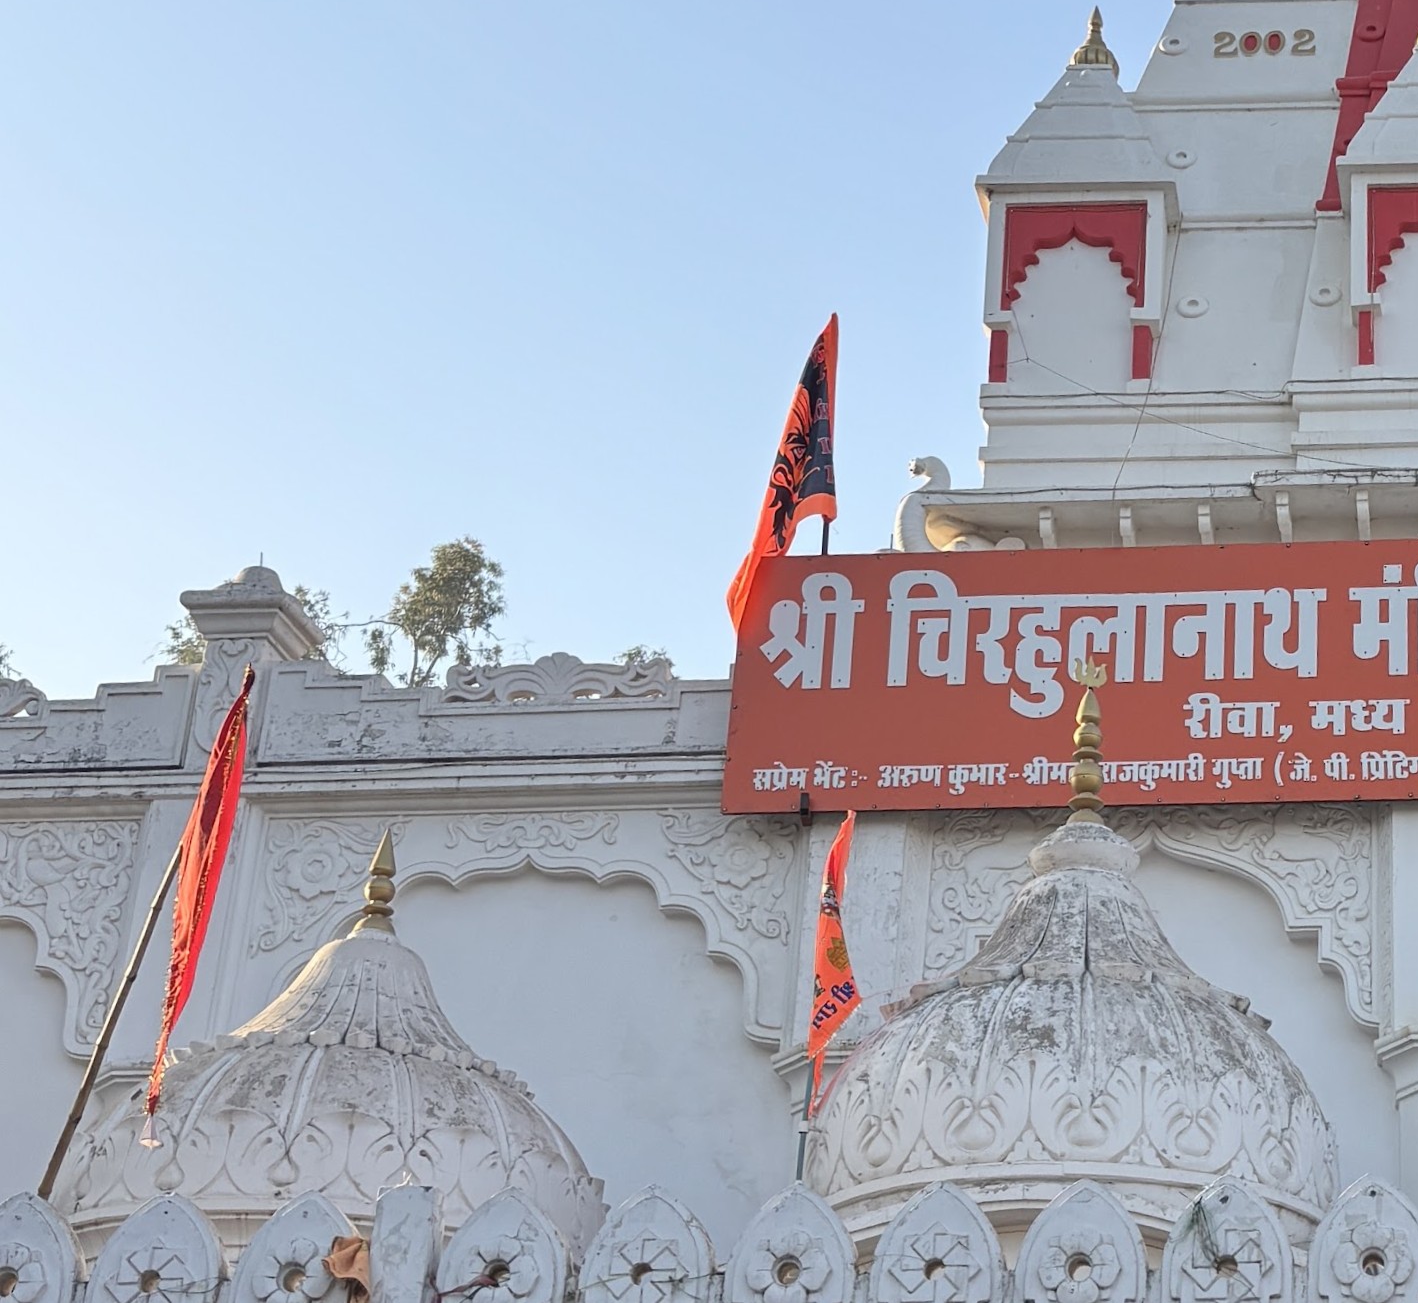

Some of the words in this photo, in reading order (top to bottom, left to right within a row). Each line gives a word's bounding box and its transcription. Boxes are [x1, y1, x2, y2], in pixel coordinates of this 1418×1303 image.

[1213, 28, 1317, 58] 2002
[760, 572, 865, 689] श्री
[887, 570, 1328, 718] चिरहुलानाथ
[1183, 692, 1293, 742] रीवा,
[1308, 699, 1411, 735] मध्य
[753, 762, 810, 791] सप्रेम
[877, 764, 944, 788] अरुण
[1098, 753, 1207, 791] राजकुमारी
[1212, 757, 1265, 789] गुप्ता
[1324, 751, 1356, 781] पी.
